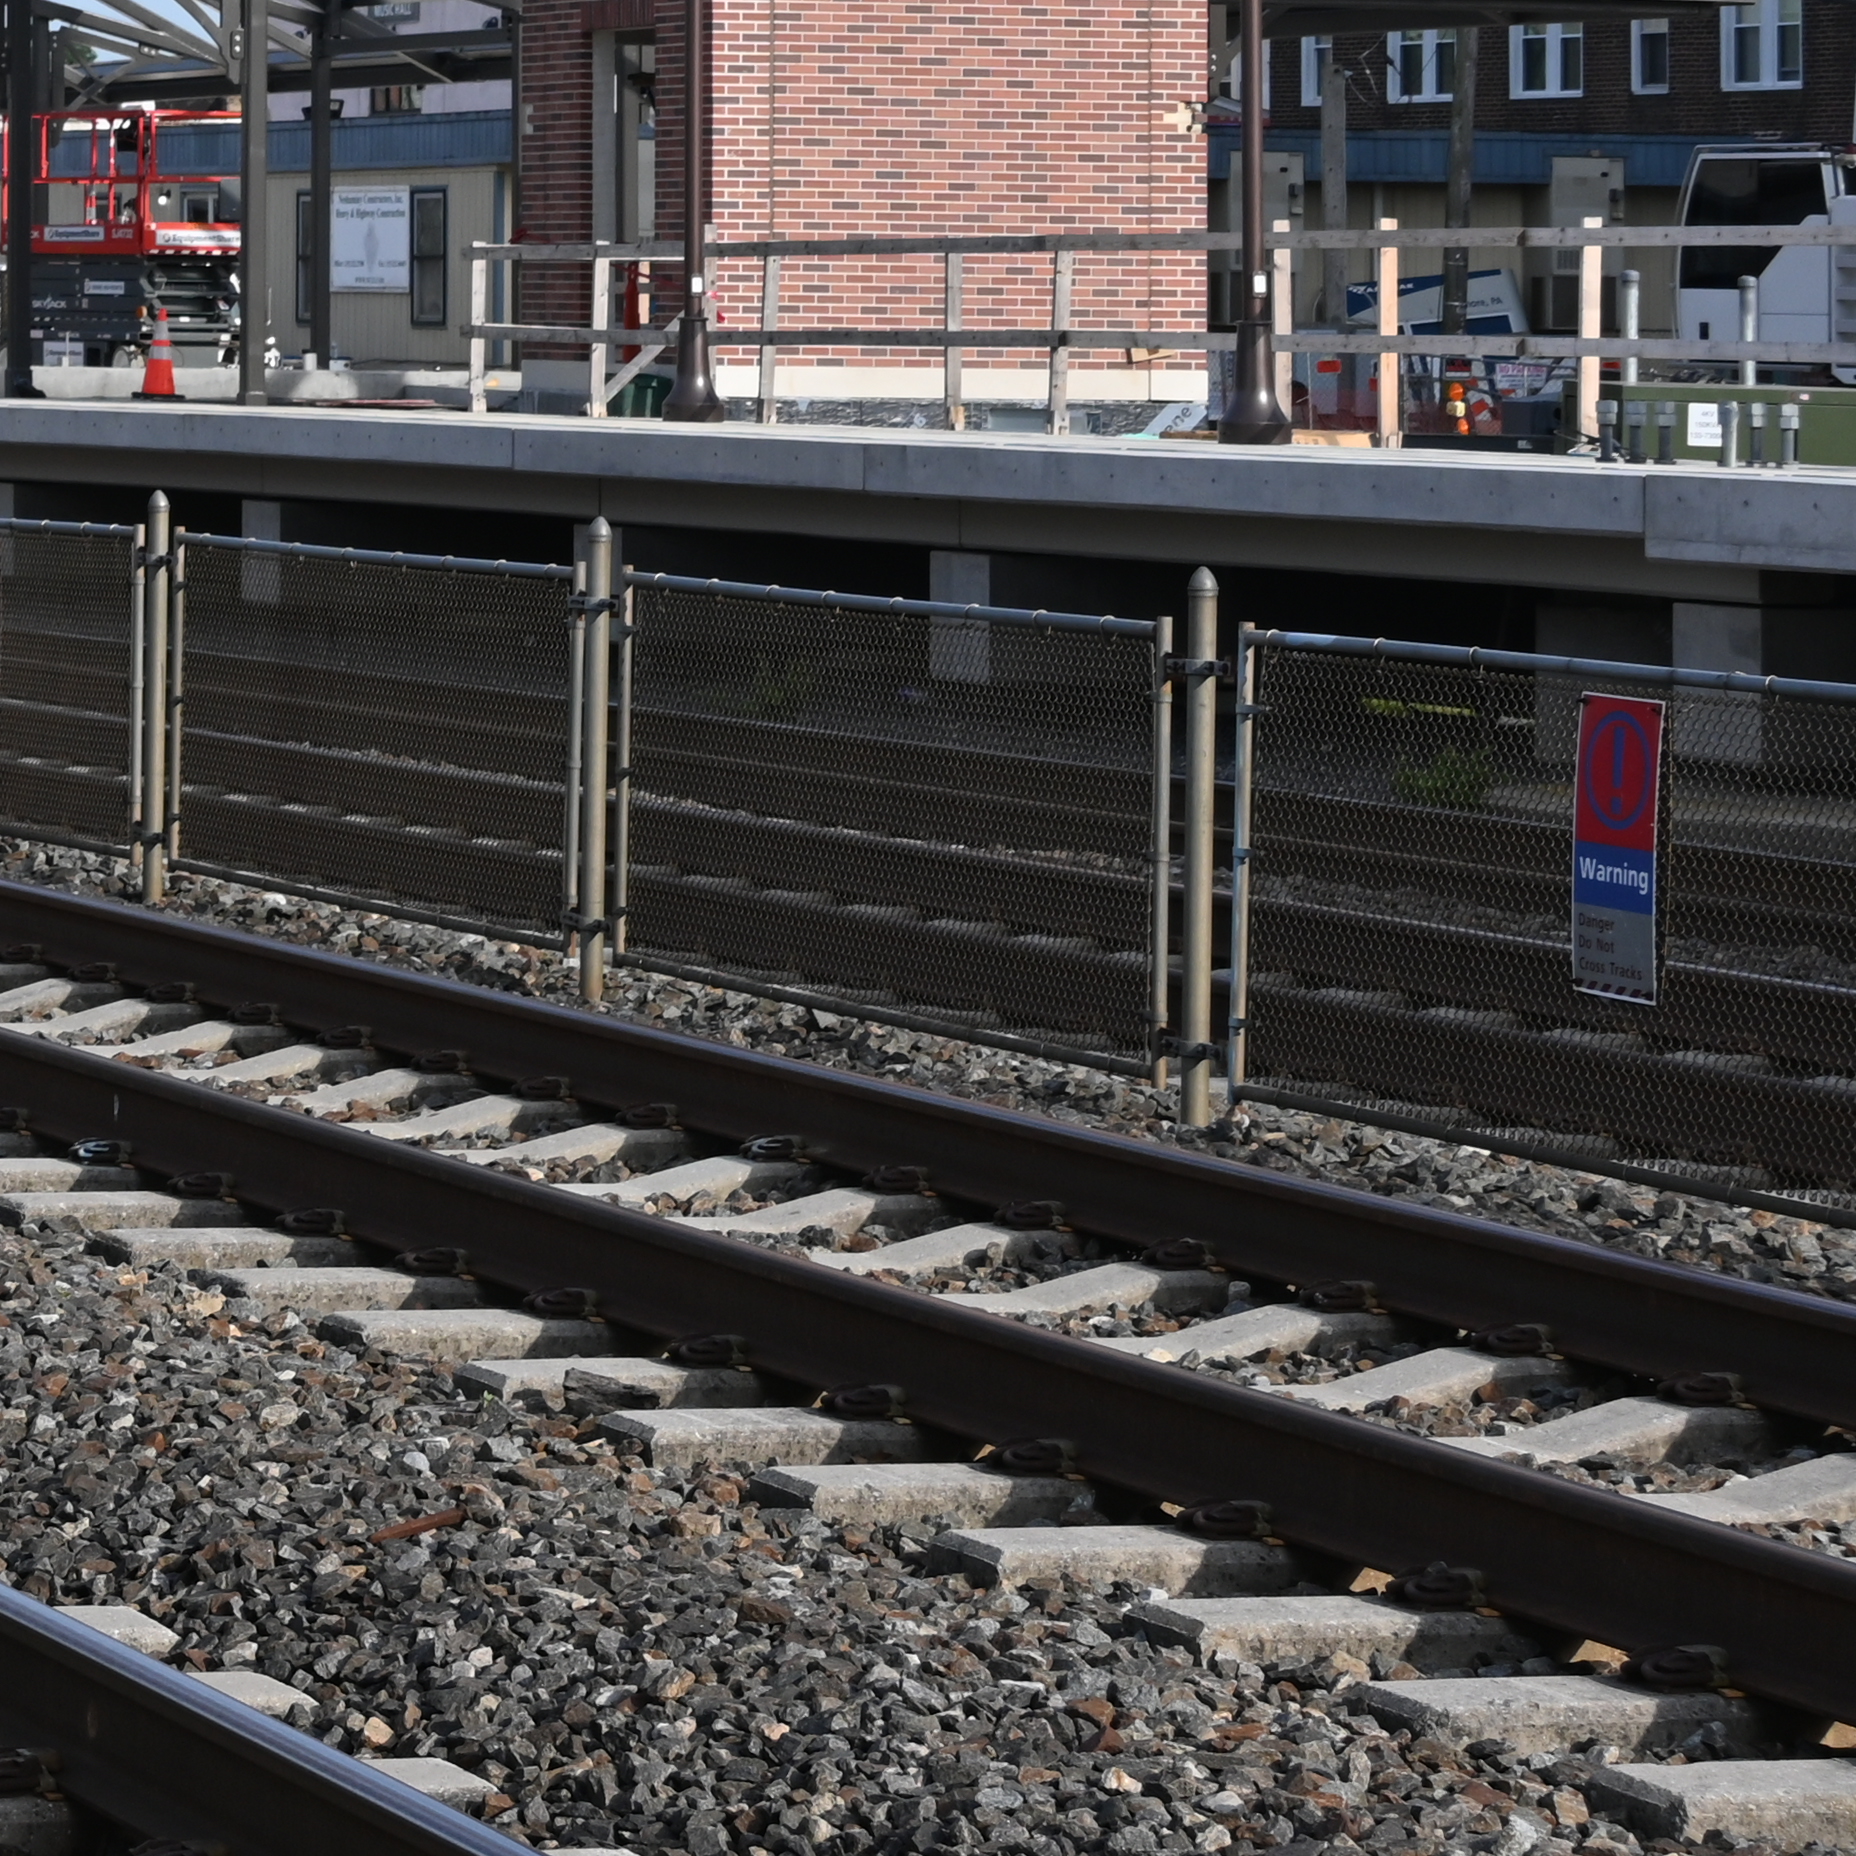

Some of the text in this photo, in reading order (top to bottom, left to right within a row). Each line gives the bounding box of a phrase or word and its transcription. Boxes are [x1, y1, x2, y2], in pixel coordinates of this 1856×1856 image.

[374, 4, 412, 17] MUSIC HALL
[1579, 856, 1649, 895] Warning
[1578, 912, 1615, 933] Danger
[1578, 934, 1615, 954] Do Not
[1579, 956, 1642, 981] Cross Tracks
